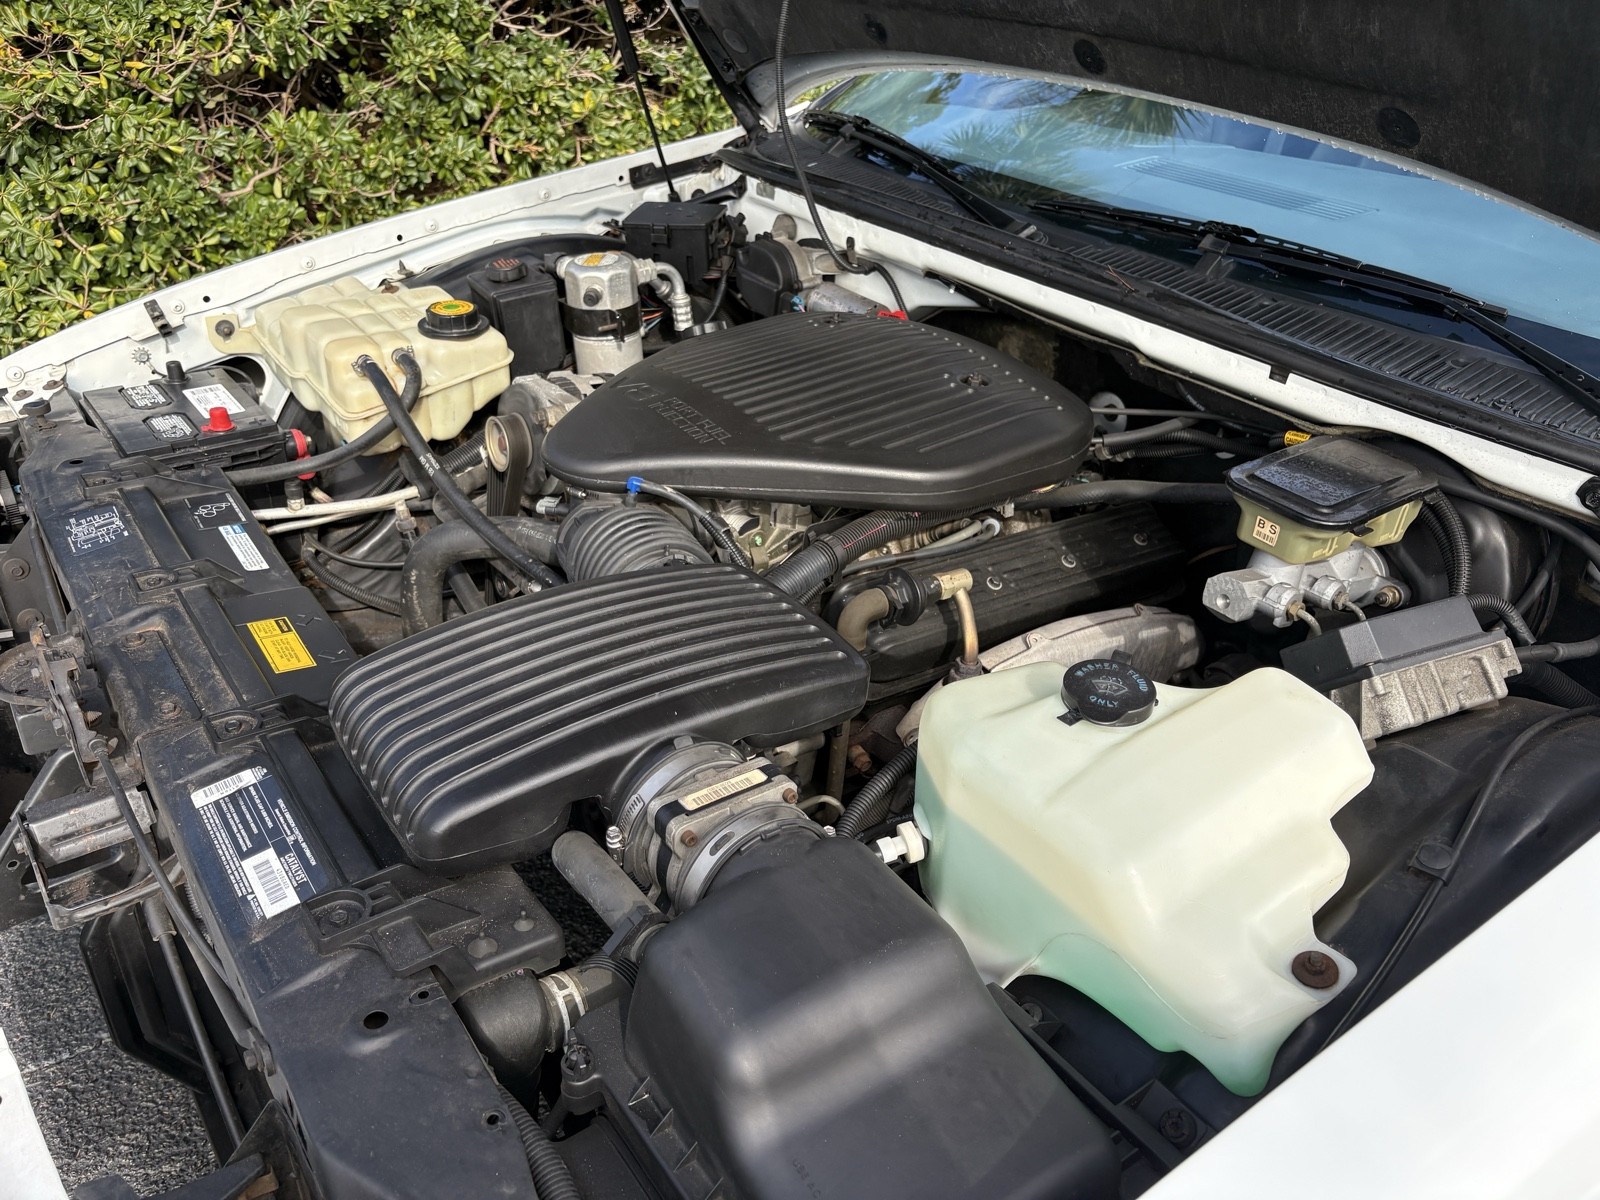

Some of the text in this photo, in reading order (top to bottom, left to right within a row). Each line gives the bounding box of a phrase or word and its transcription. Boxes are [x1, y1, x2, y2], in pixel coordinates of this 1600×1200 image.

[648, 401, 715, 444] INJECTION
[663, 396, 732, 445] PORT FUEL
[1257, 518, 1277, 535] B S
[1074, 662, 1149, 692] WASHER FLUID
[1089, 695, 1119, 708] ONLY
[284, 851, 307, 884] CATALYST
[300, 841, 316, 866] INFORMATION
